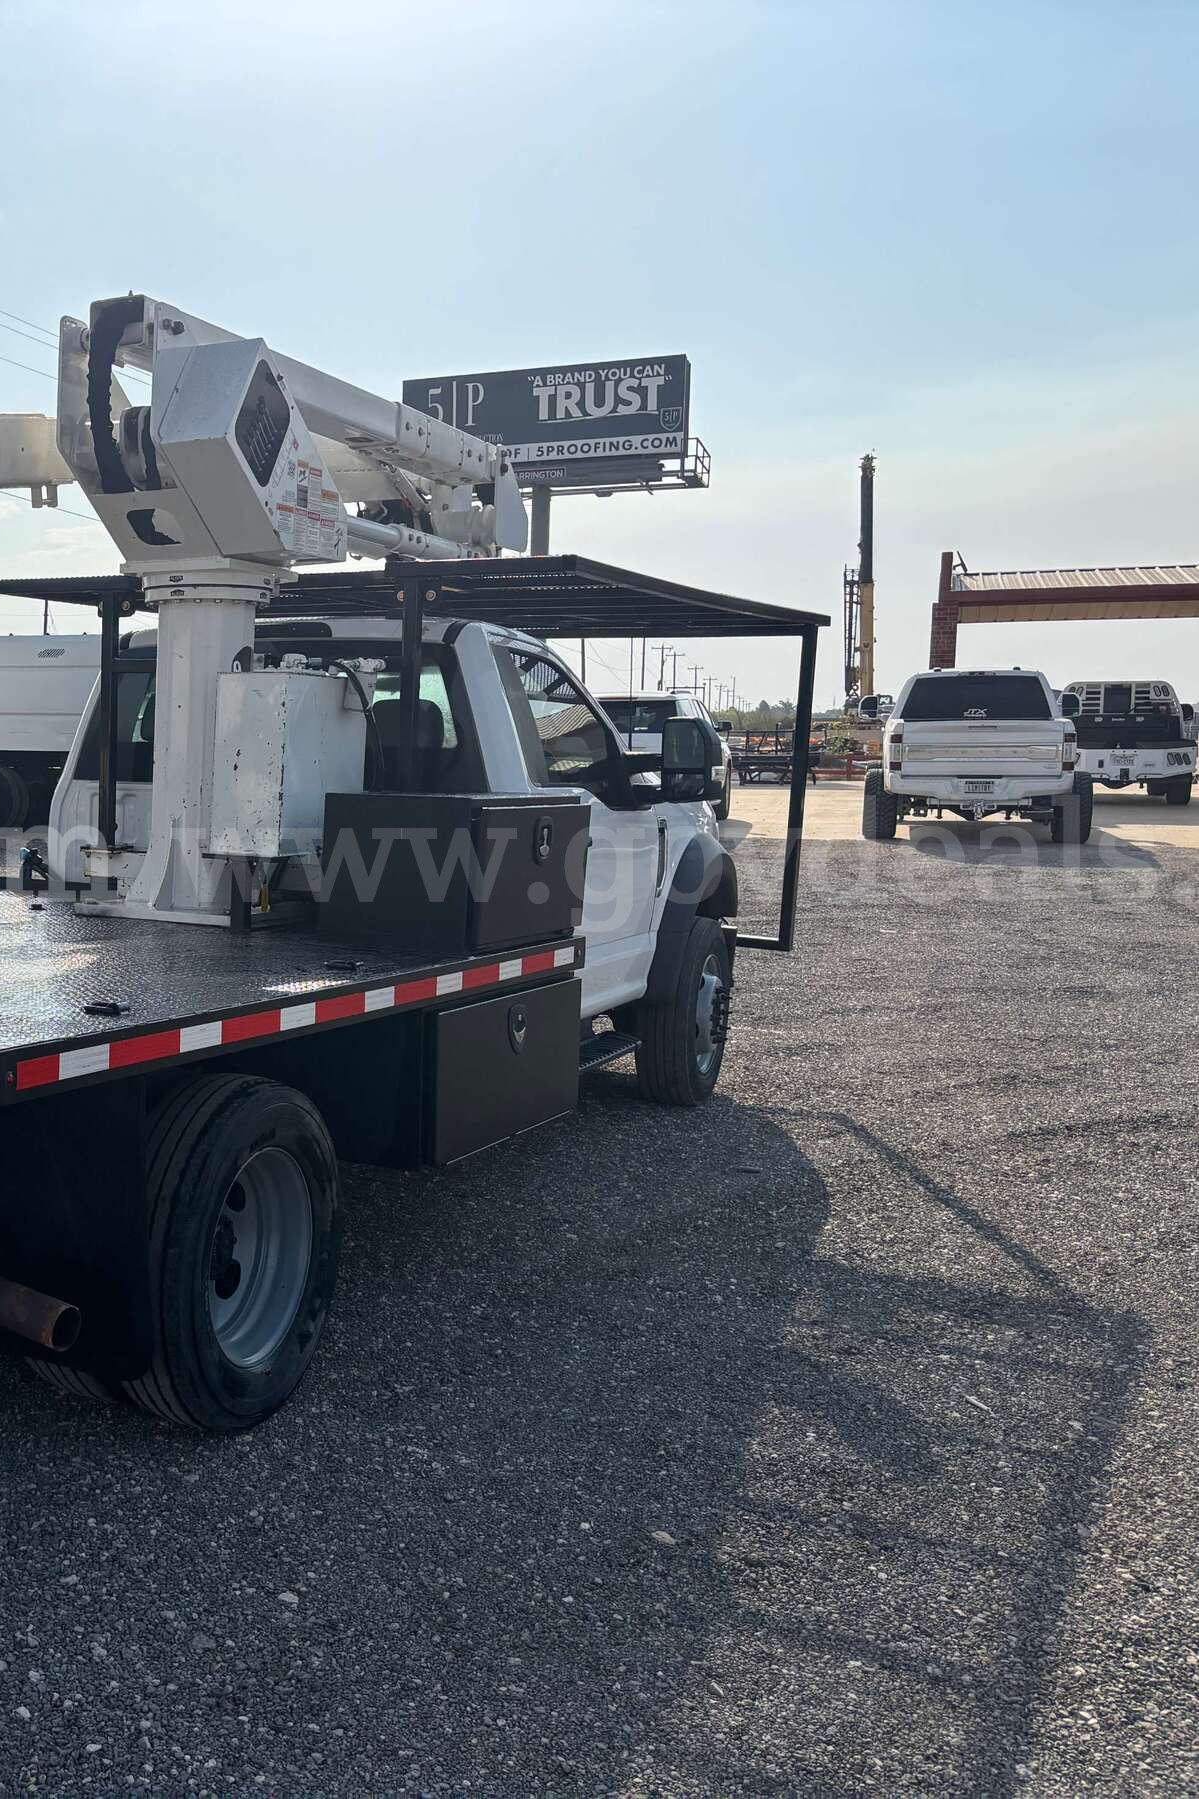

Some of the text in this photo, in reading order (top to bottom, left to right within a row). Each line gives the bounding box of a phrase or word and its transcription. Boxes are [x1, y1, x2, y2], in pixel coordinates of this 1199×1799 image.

[546, 371, 595, 386] BRAND
[599, 367, 630, 381] YOU
[634, 364, 665, 378] CAN
[536, 436, 679, 457] 5PROOFING.COM
